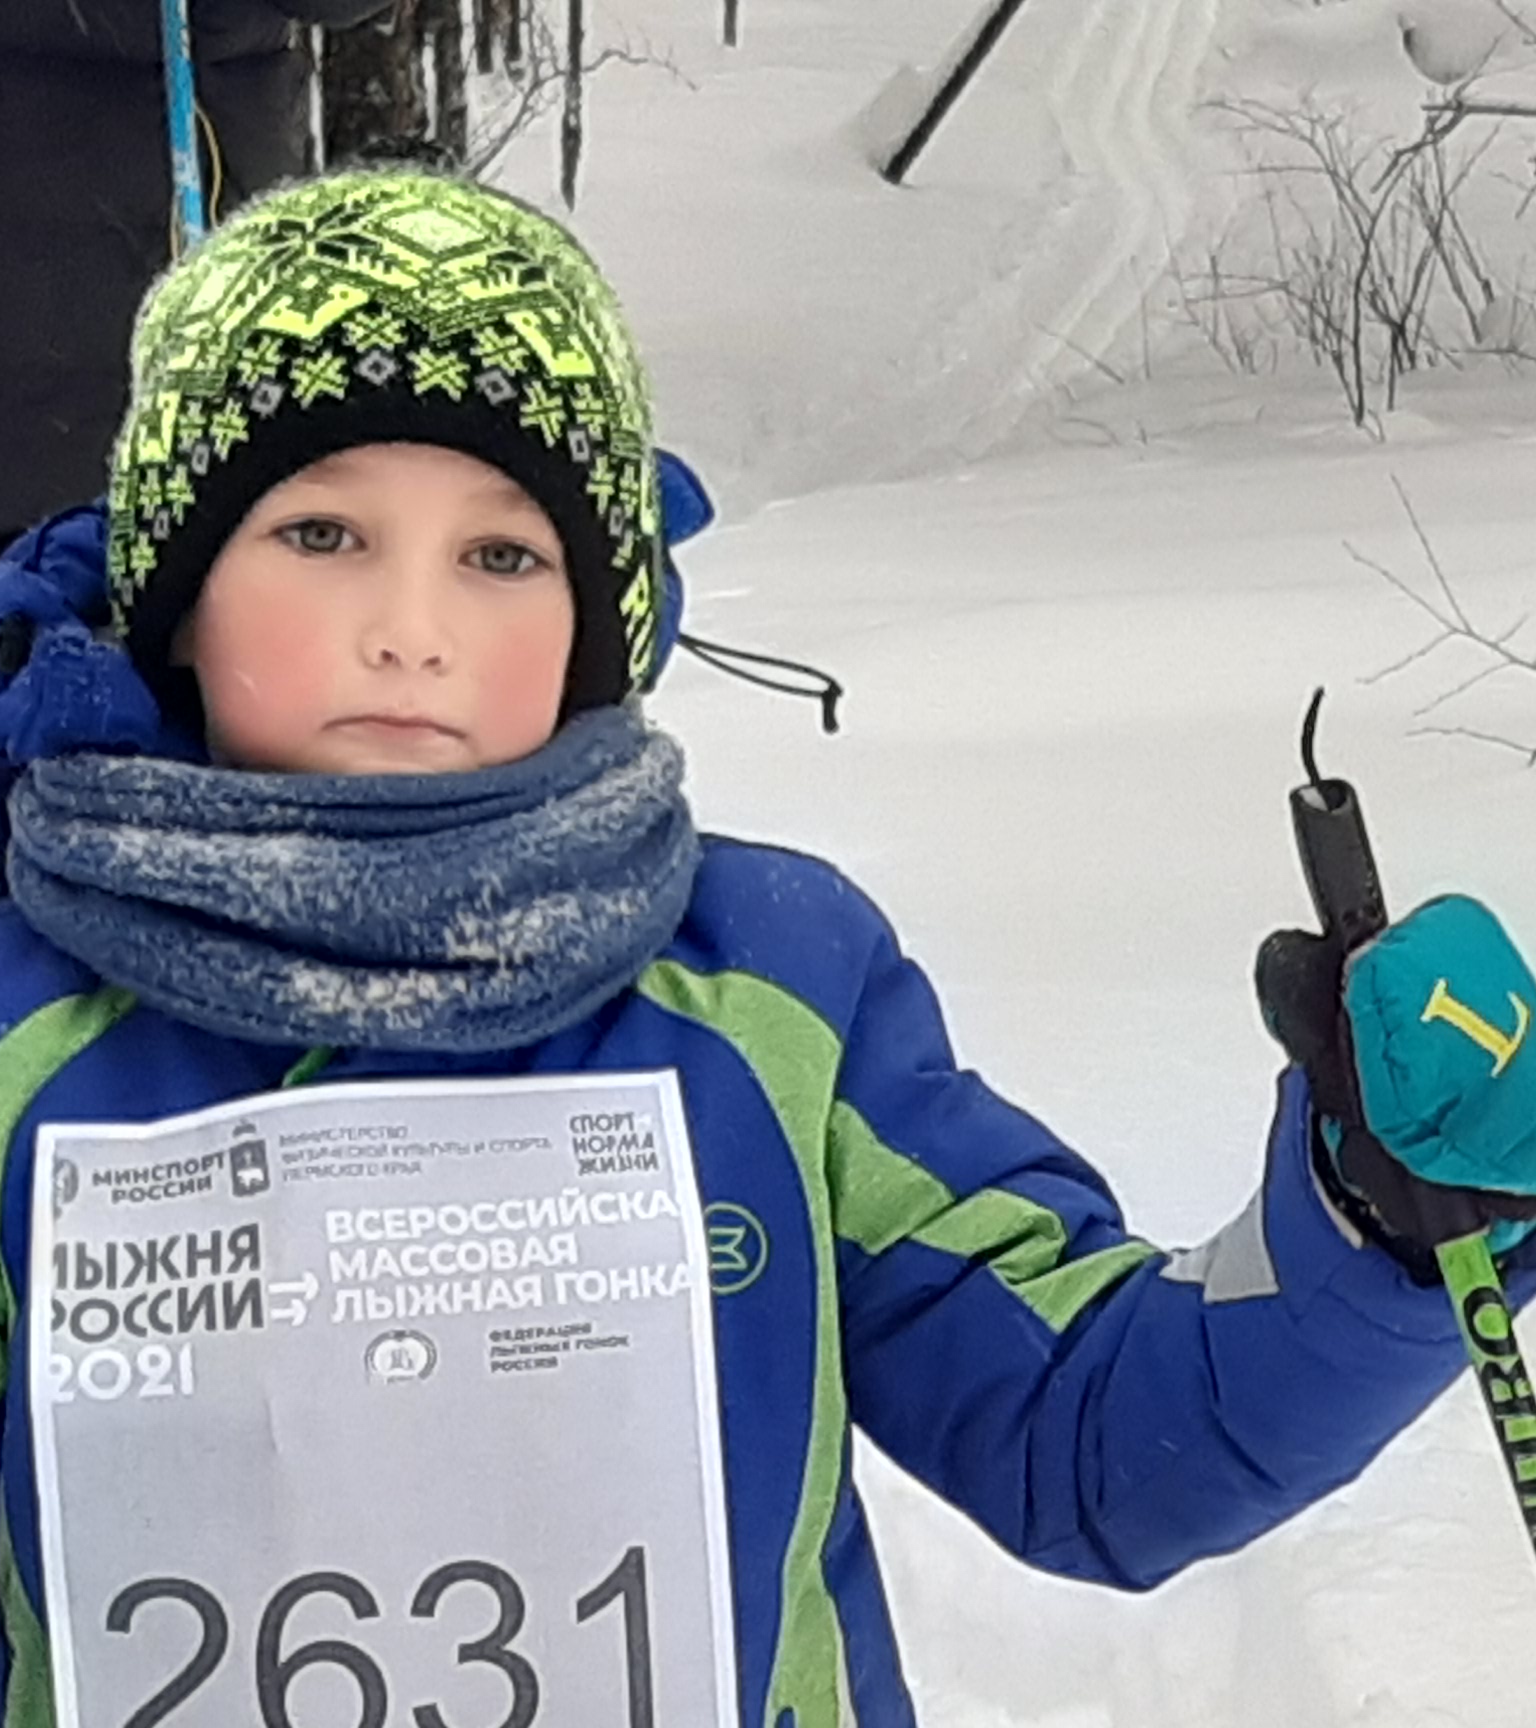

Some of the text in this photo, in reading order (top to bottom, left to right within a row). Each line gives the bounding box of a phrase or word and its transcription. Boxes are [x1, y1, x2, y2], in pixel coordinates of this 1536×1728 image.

[570, 1112, 634, 1133] СПОРТ
[572, 1132, 654, 1155] НОРМА
[92, 1151, 226, 1186] МИНСПОРТ
[578, 1152, 659, 1176] ЖИЗНИ
[112, 1175, 212, 1204] РОССИИ
[328, 1232, 579, 1284] МАССОВАЯ
[330, 1262, 696, 1323] ЛЫЖНАЯ ГОНКА
